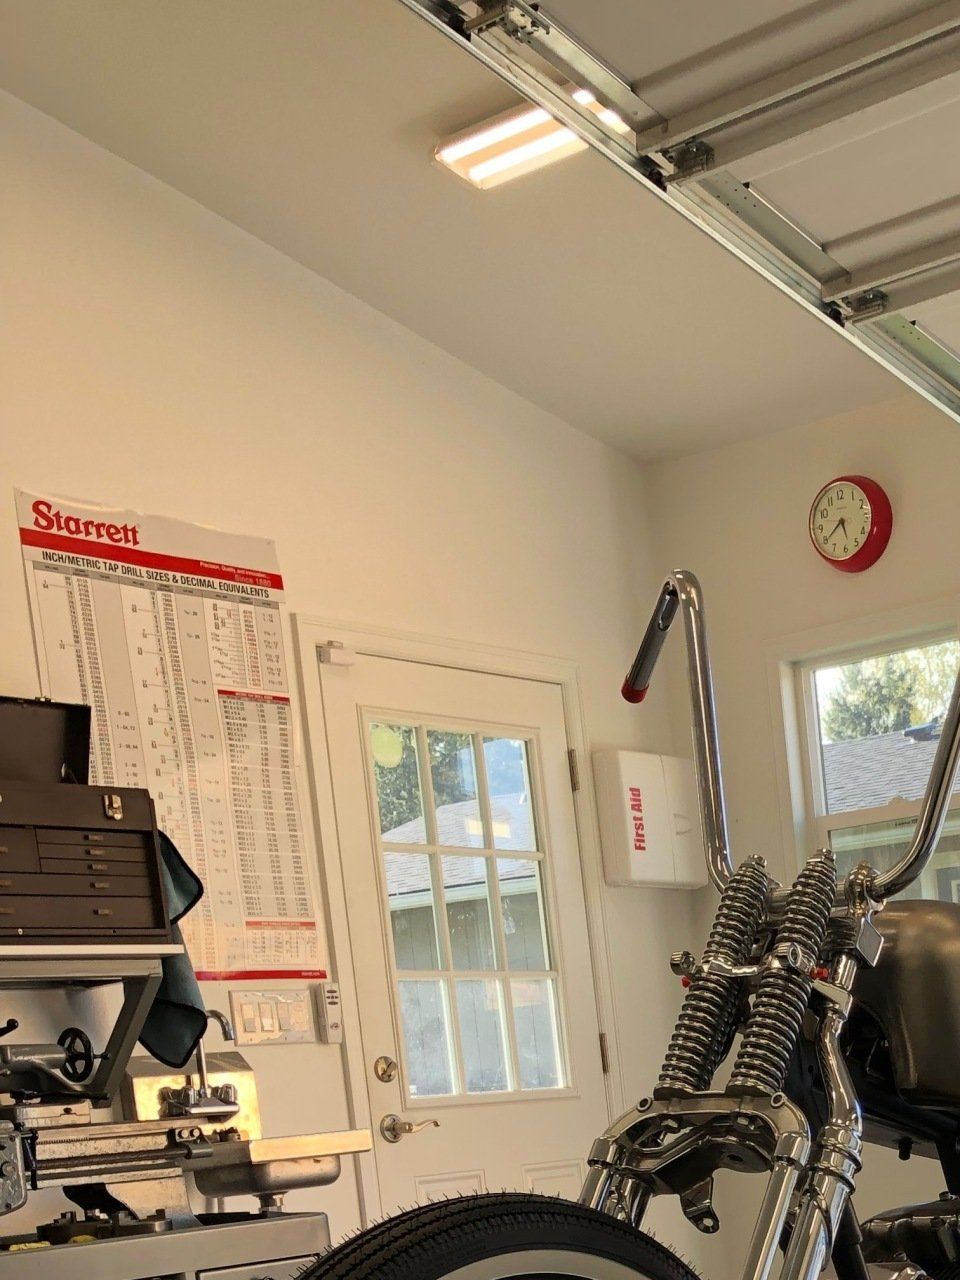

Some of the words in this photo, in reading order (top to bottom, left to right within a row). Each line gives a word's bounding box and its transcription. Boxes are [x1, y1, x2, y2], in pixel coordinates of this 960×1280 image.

[837, 490, 844, 500] 12
[828, 497, 833, 507] 11
[859, 499, 864, 509] 2
[821, 508, 828, 519] 10
[32, 500, 140, 546] Starrett
[818, 524, 823, 533] 9
[843, 544, 848, 553] 6
[42, 550, 101, 570] INCH/METRIC
[103, 561, 119, 573] TAP
[121, 565, 145, 579] DRILL
[145, 570, 170, 582] SIZES
[171, 575, 178, 583] &
[180, 575, 217, 590] DECIMAL
[219, 581, 270, 598] EQUIVALENTS
[629, 787, 642, 813] Aid
[634, 816, 646, 851] First
